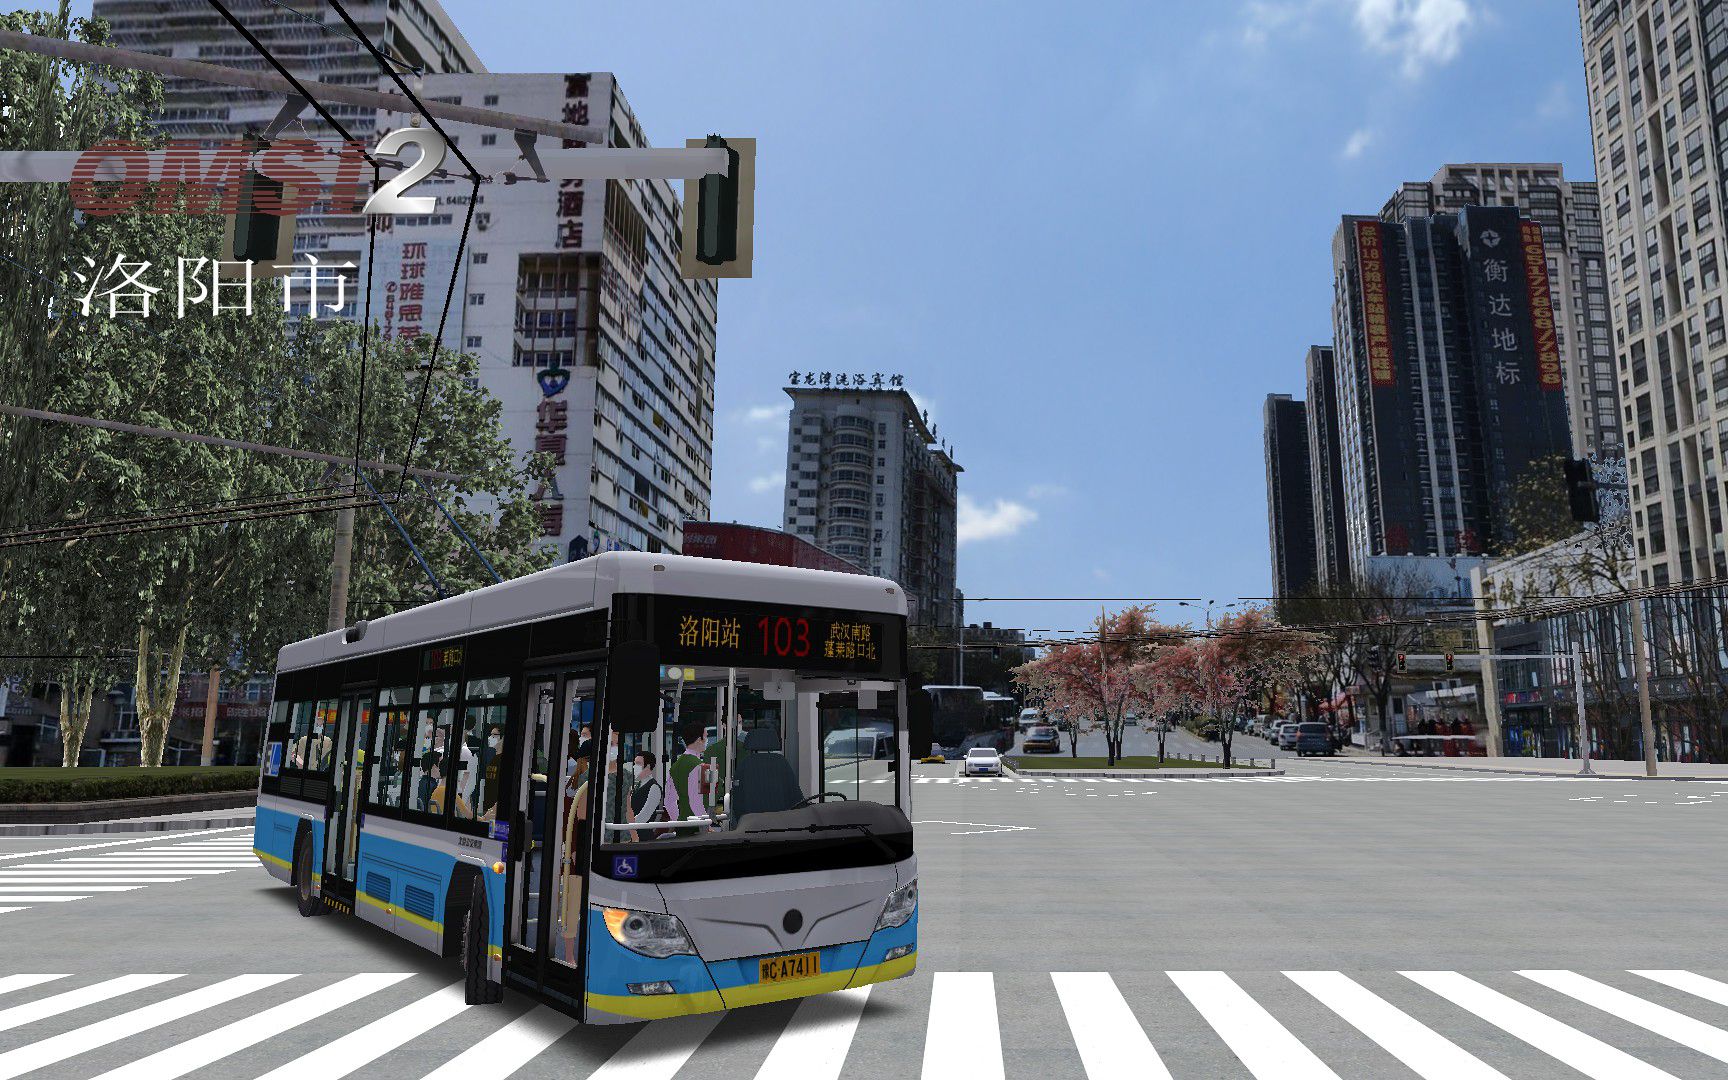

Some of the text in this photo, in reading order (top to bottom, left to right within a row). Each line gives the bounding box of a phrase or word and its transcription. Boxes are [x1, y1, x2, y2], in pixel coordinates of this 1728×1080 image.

[1483, 258, 1520, 385] 衡达地标
[679, 615, 811, 657] 洛阳站 103
[830, 621, 871, 641] 武汉南路
